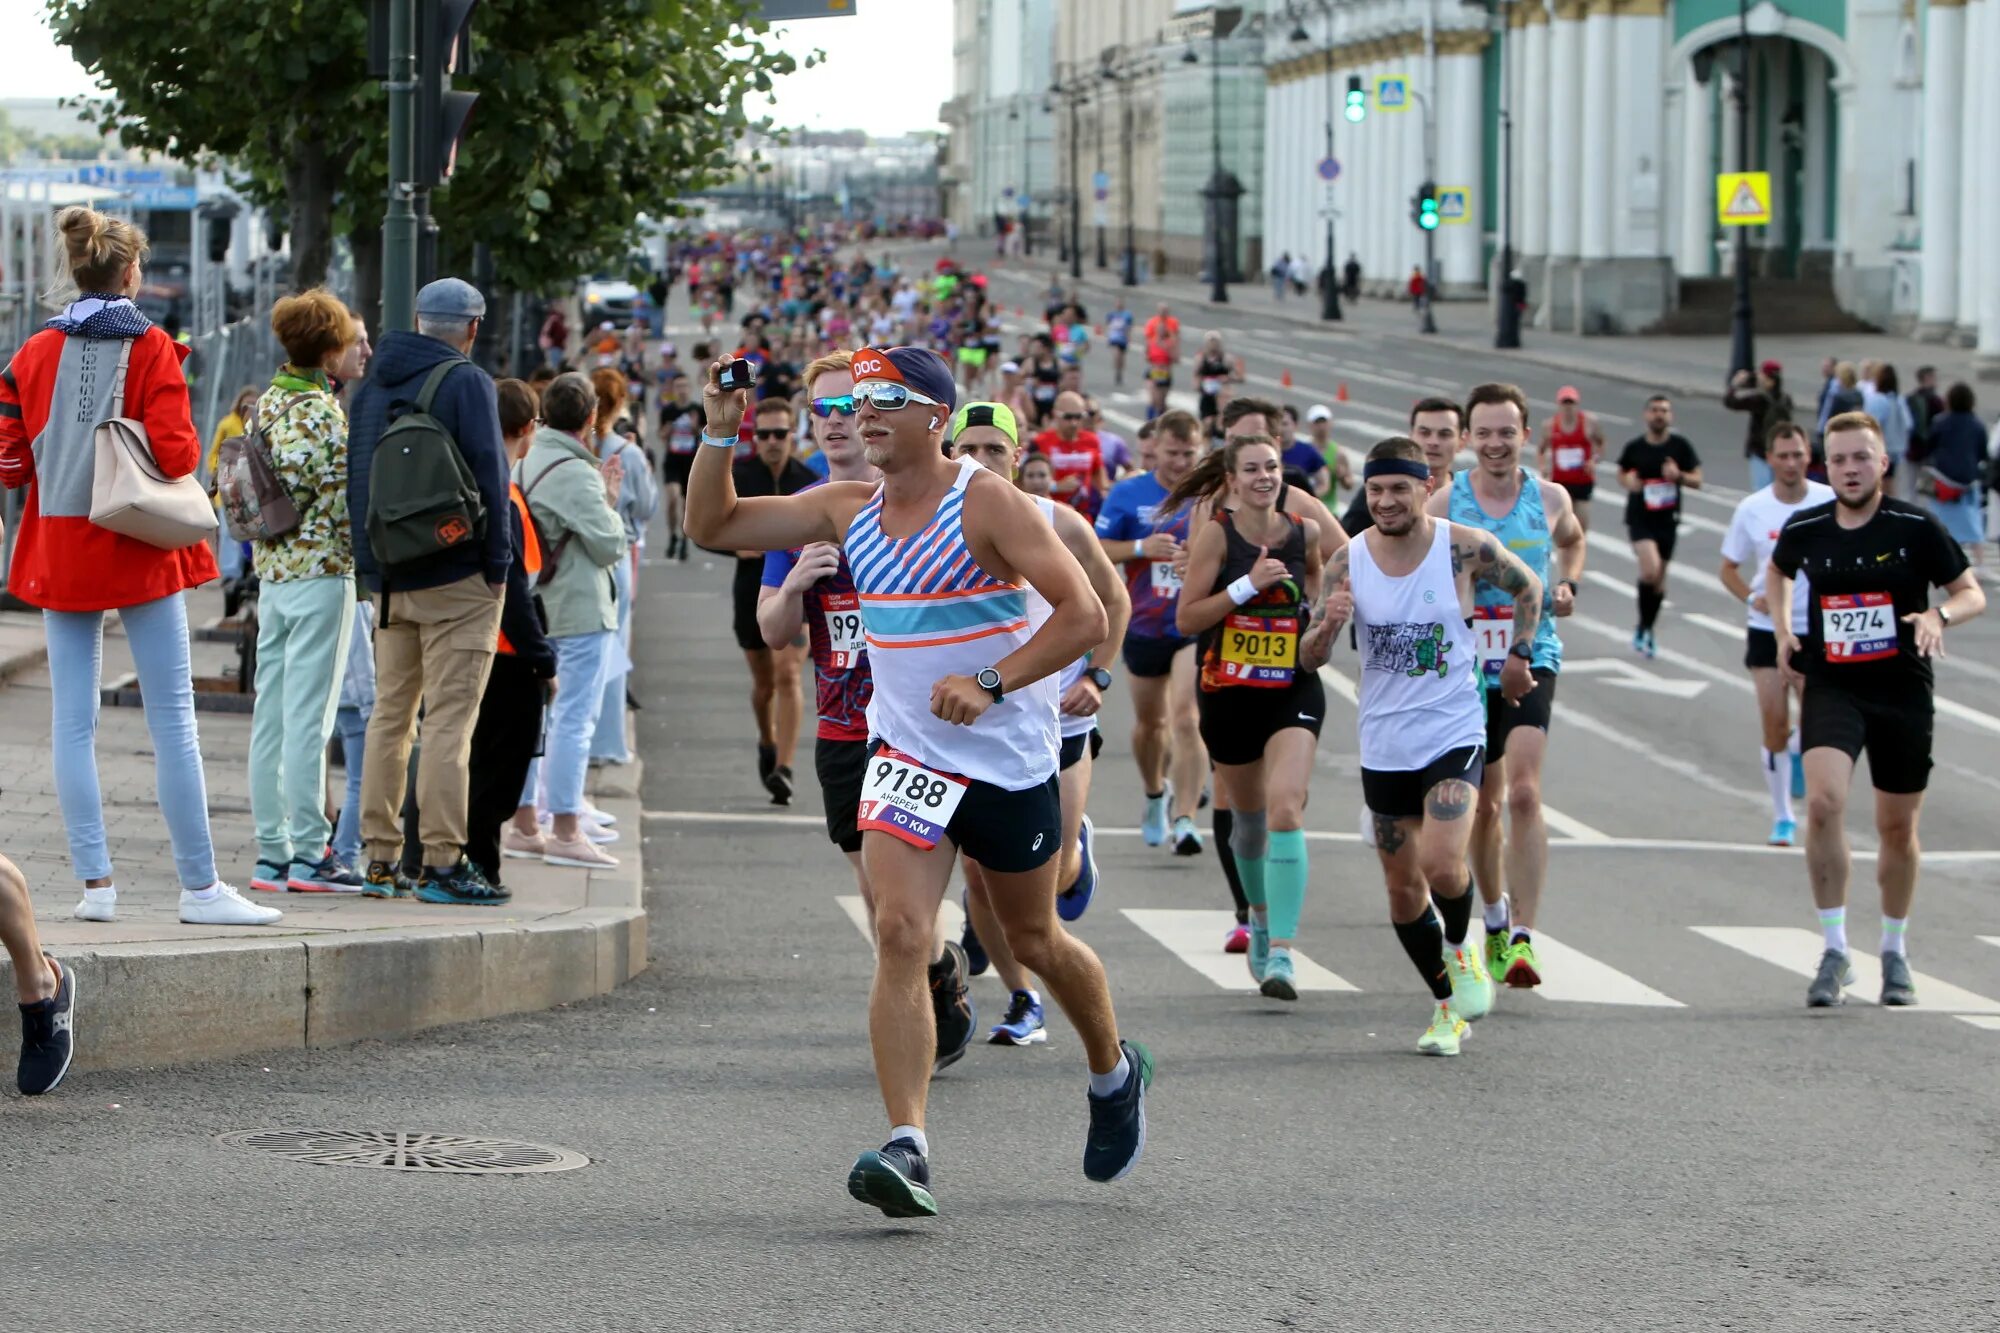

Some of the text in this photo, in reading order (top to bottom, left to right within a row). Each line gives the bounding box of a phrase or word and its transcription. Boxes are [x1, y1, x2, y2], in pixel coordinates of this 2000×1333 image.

[833, 614, 866, 640] 99
[1831, 610, 1885, 632] 9274
[1233, 632, 1286, 657] 9013
[836, 652, 845, 667] B
[1226, 662, 1236, 675] B
[1259, 669, 1270, 678] 10
[873, 761, 948, 808] 9188
[861, 802, 869, 819] B
[880, 792, 919, 812] АНДРЕЙ
[893, 811, 908, 825] 10
